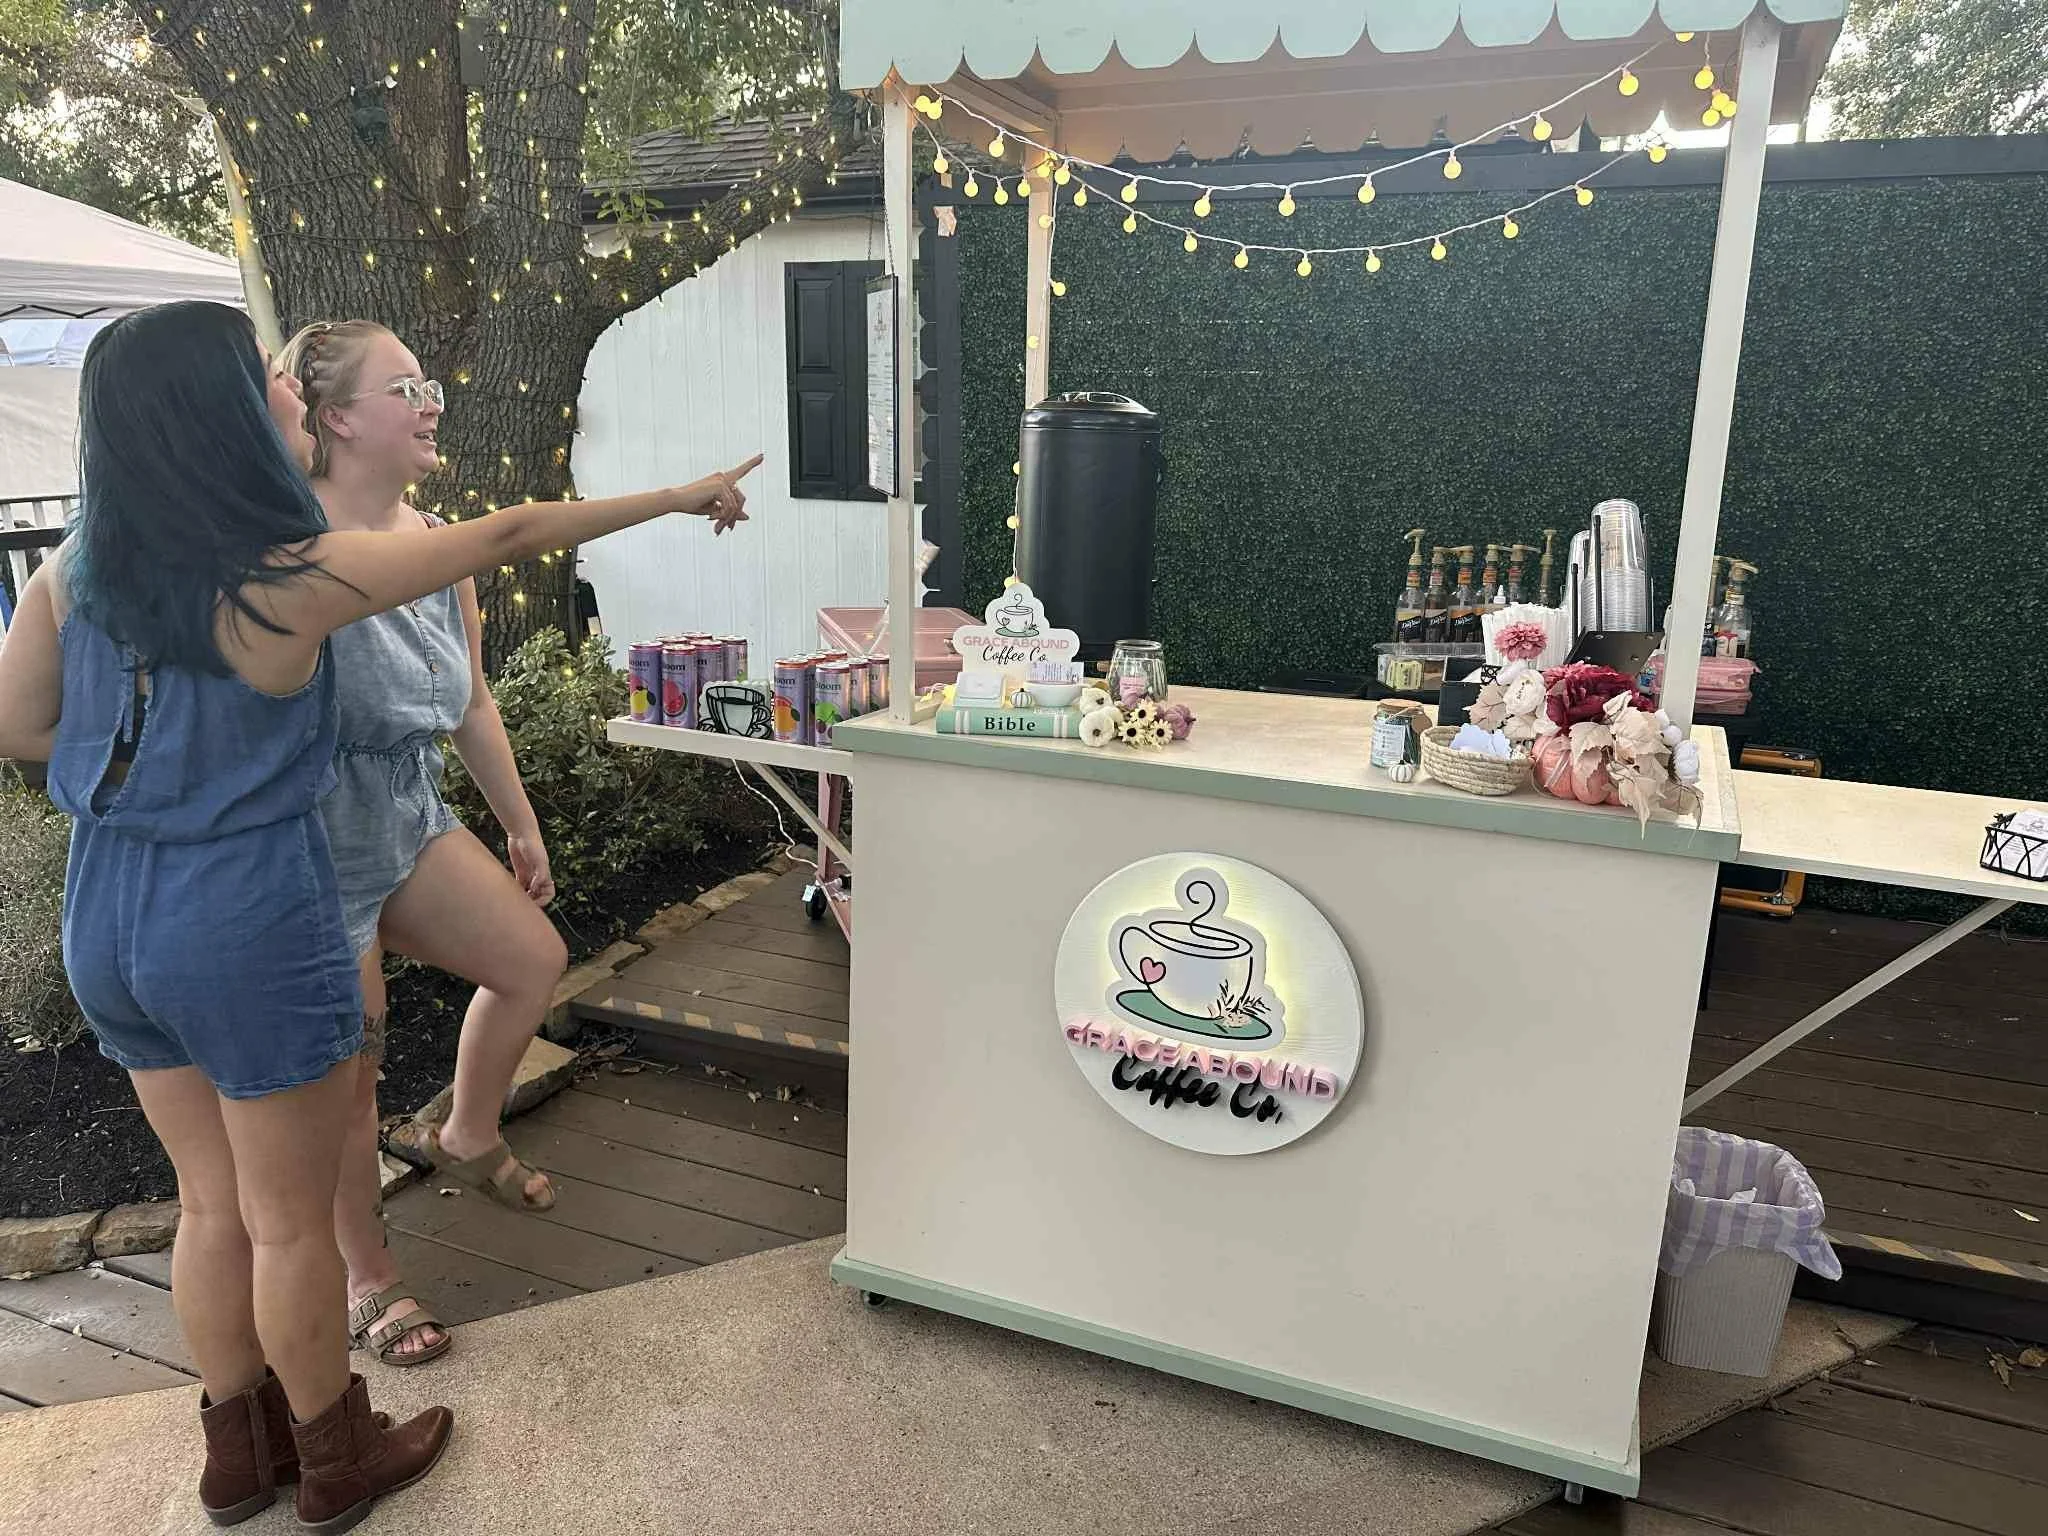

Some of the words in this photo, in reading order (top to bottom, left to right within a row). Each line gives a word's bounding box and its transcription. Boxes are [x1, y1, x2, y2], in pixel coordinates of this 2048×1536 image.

[963, 636, 1009, 648] GRACE
[1012, 638, 1070, 650] ABOUND
[983, 645, 1025, 665] Coffee
[984, 716, 1036, 732] Bible
[1064, 1017, 1183, 1065] GRACE
[1184, 1054, 1338, 1099] ABOUND
[1112, 1054, 1221, 1109] Coffee
